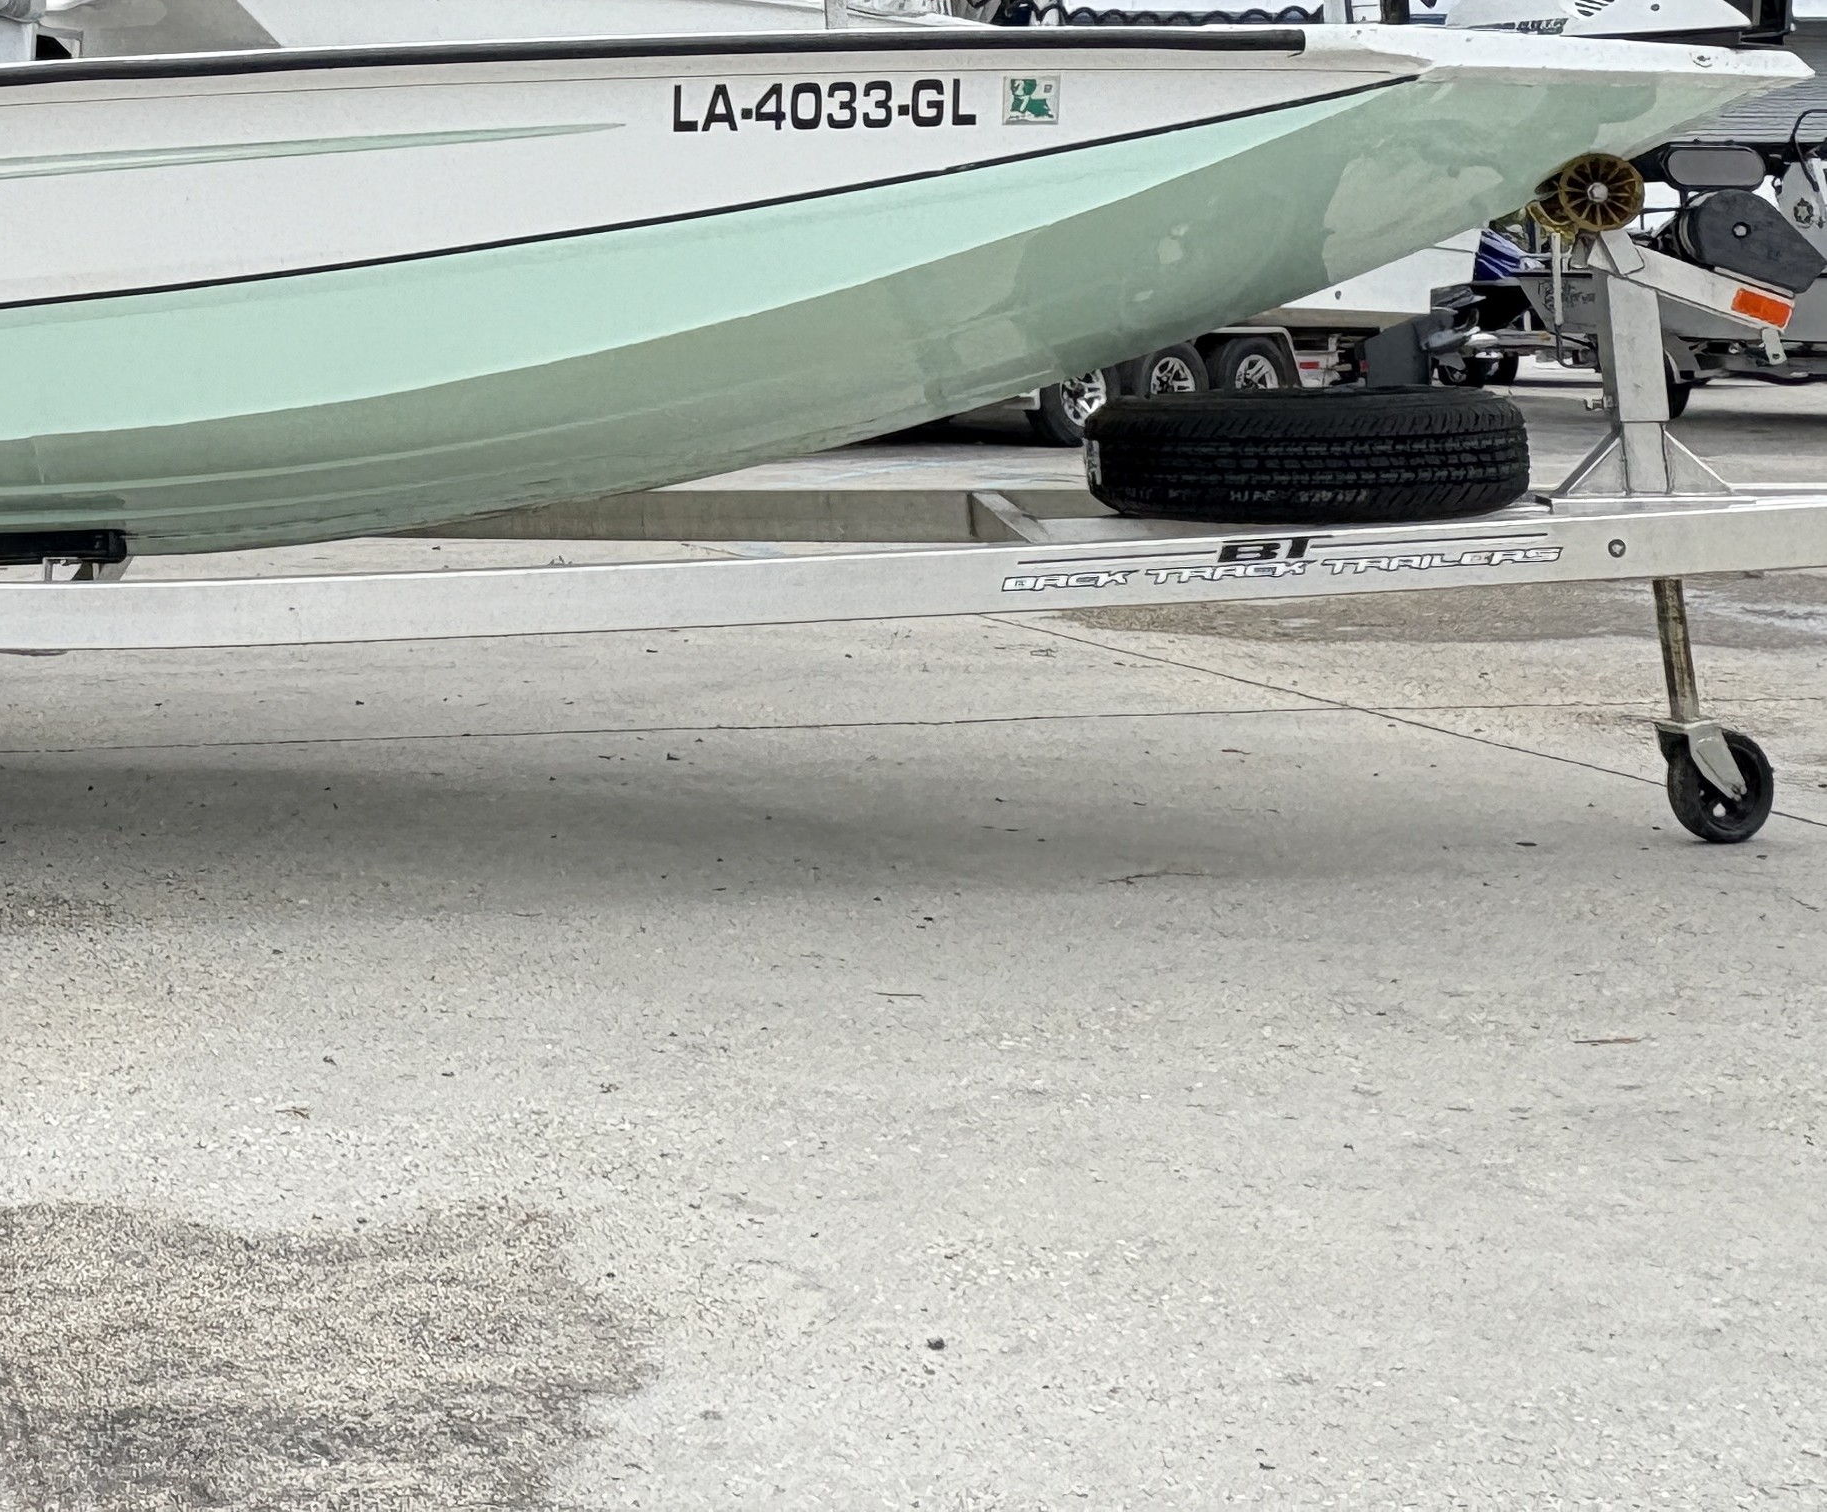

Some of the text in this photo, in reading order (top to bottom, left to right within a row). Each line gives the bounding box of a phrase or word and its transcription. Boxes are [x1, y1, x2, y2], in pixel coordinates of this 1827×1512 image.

[672, 78, 977, 133] LA-4033-GL
[1145, 559, 1318, 586] TRACK
[1321, 546, 1565, 577] TRAILERS
